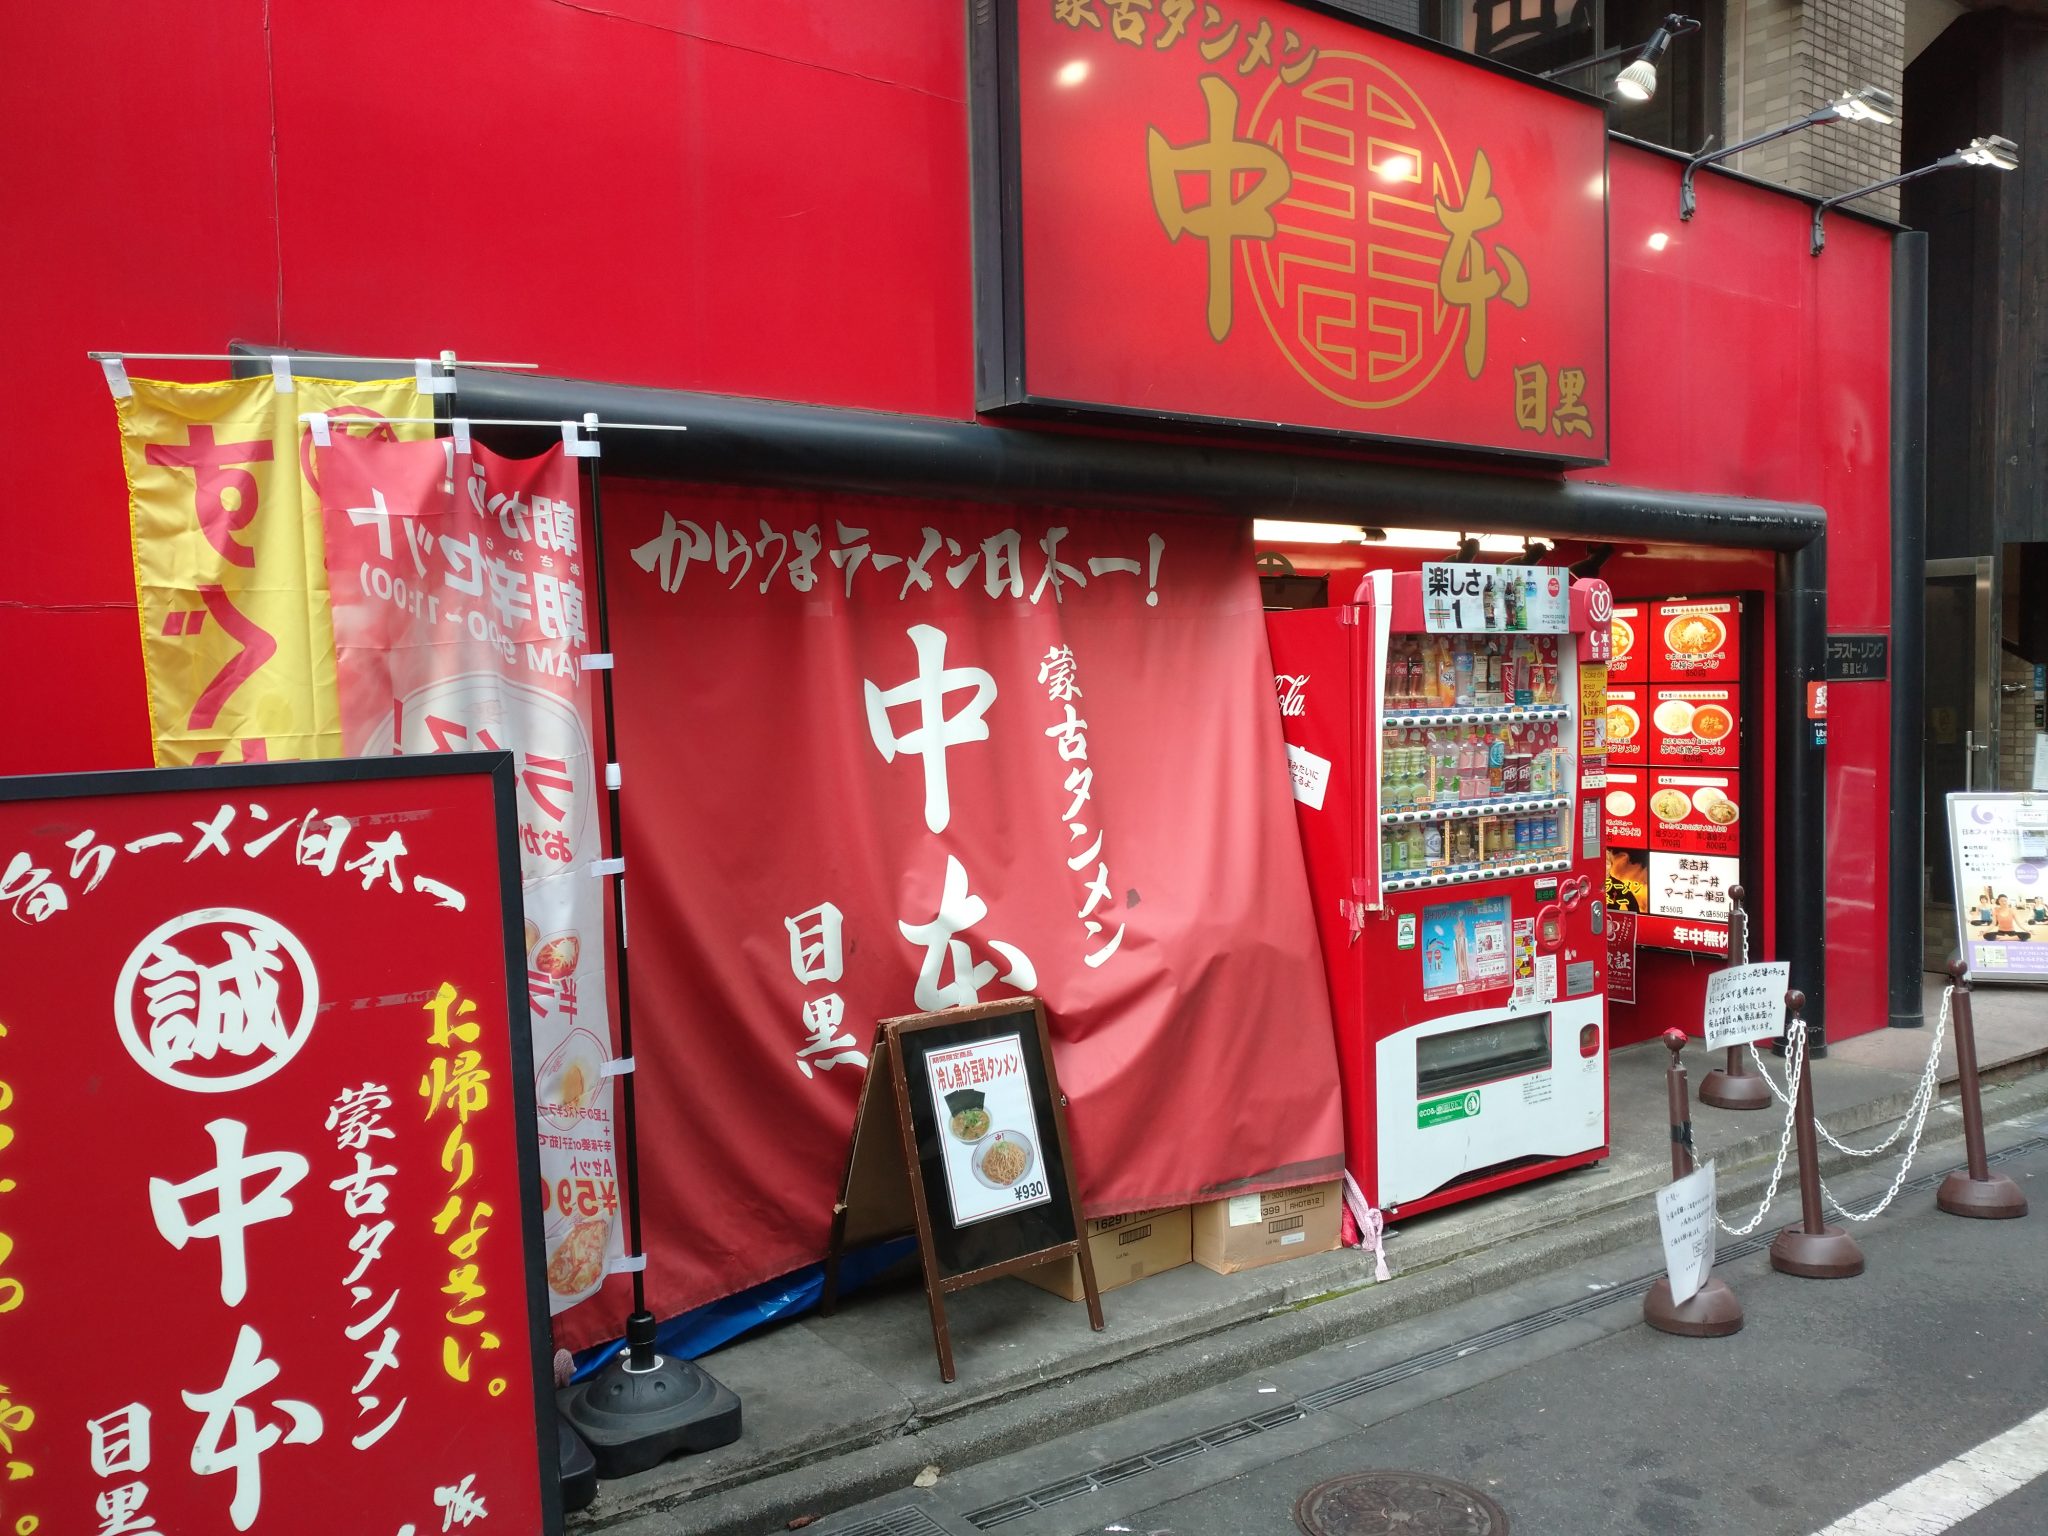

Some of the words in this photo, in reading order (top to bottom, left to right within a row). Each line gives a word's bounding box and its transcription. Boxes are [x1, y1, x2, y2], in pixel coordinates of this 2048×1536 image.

[1513, 363, 1593, 439] 目黒
[1428, 566, 1482, 597] 楽しさ
[863, 623, 1037, 1010] 中本
[1037, 643, 1127, 968] 蒙古タンメン
[1664, 887, 1725, 904] マーボー単品
[1669, 873, 1720, 888] マーボー丼
[1679, 859, 1709, 872] 蒙古丼
[140, 929, 292, 1069] 誠
[784, 901, 868, 1079] 目黒
[935, 1053, 1019, 1091] 冷し魚介豆乳タンメン
[418, 981, 506, 1396] お帰りなさい。
[1014, 1180, 1044, 1201] ¥930
[325, 1082, 407, 1450] 蒙古タンメン
[148, 1117, 324, 1531] 中本
